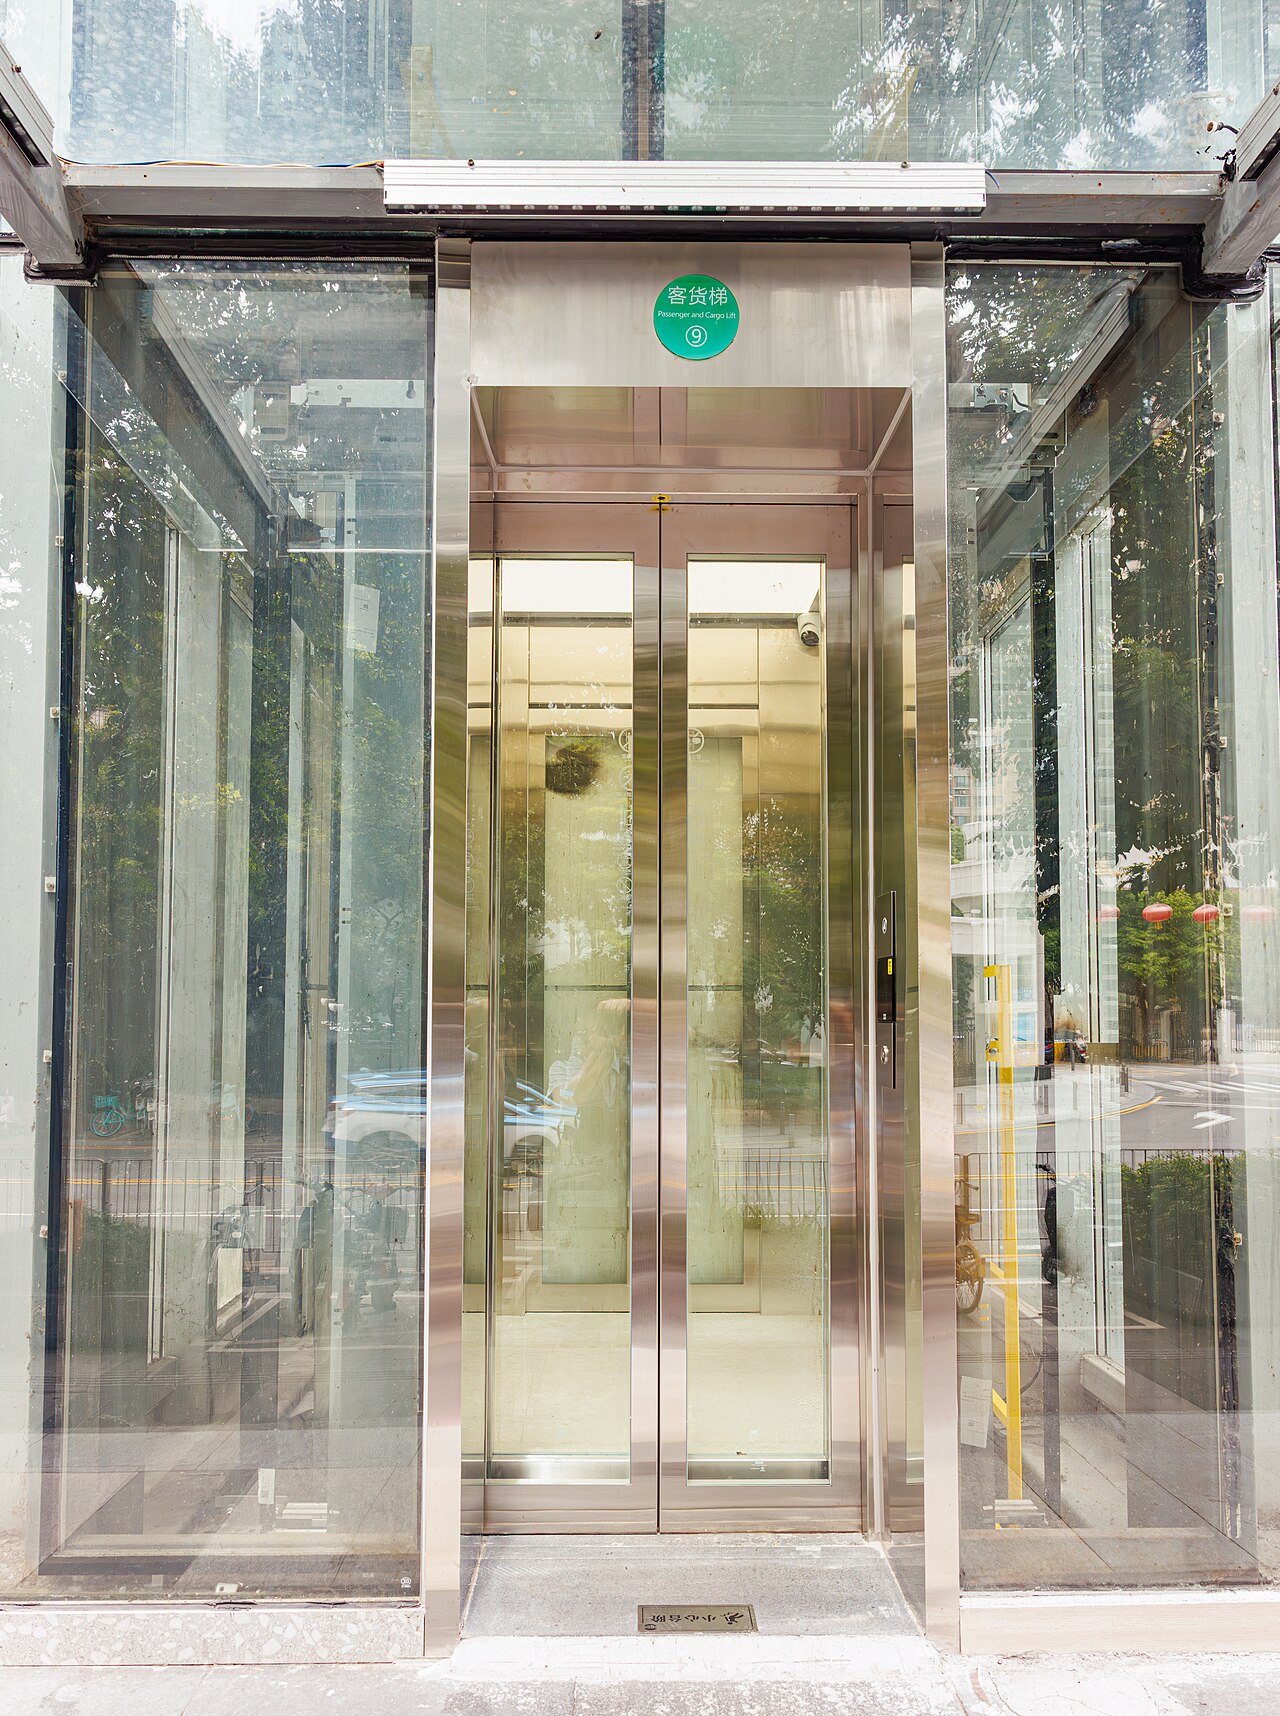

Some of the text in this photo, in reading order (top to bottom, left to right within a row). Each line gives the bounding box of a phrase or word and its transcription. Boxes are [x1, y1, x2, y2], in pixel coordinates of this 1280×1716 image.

[668, 286, 728, 306] 客货梯
[658, 310, 690, 319] Passenger
[705, 312, 725, 320] Cargo
[651, 1614, 717, 1623] 小心台阶
